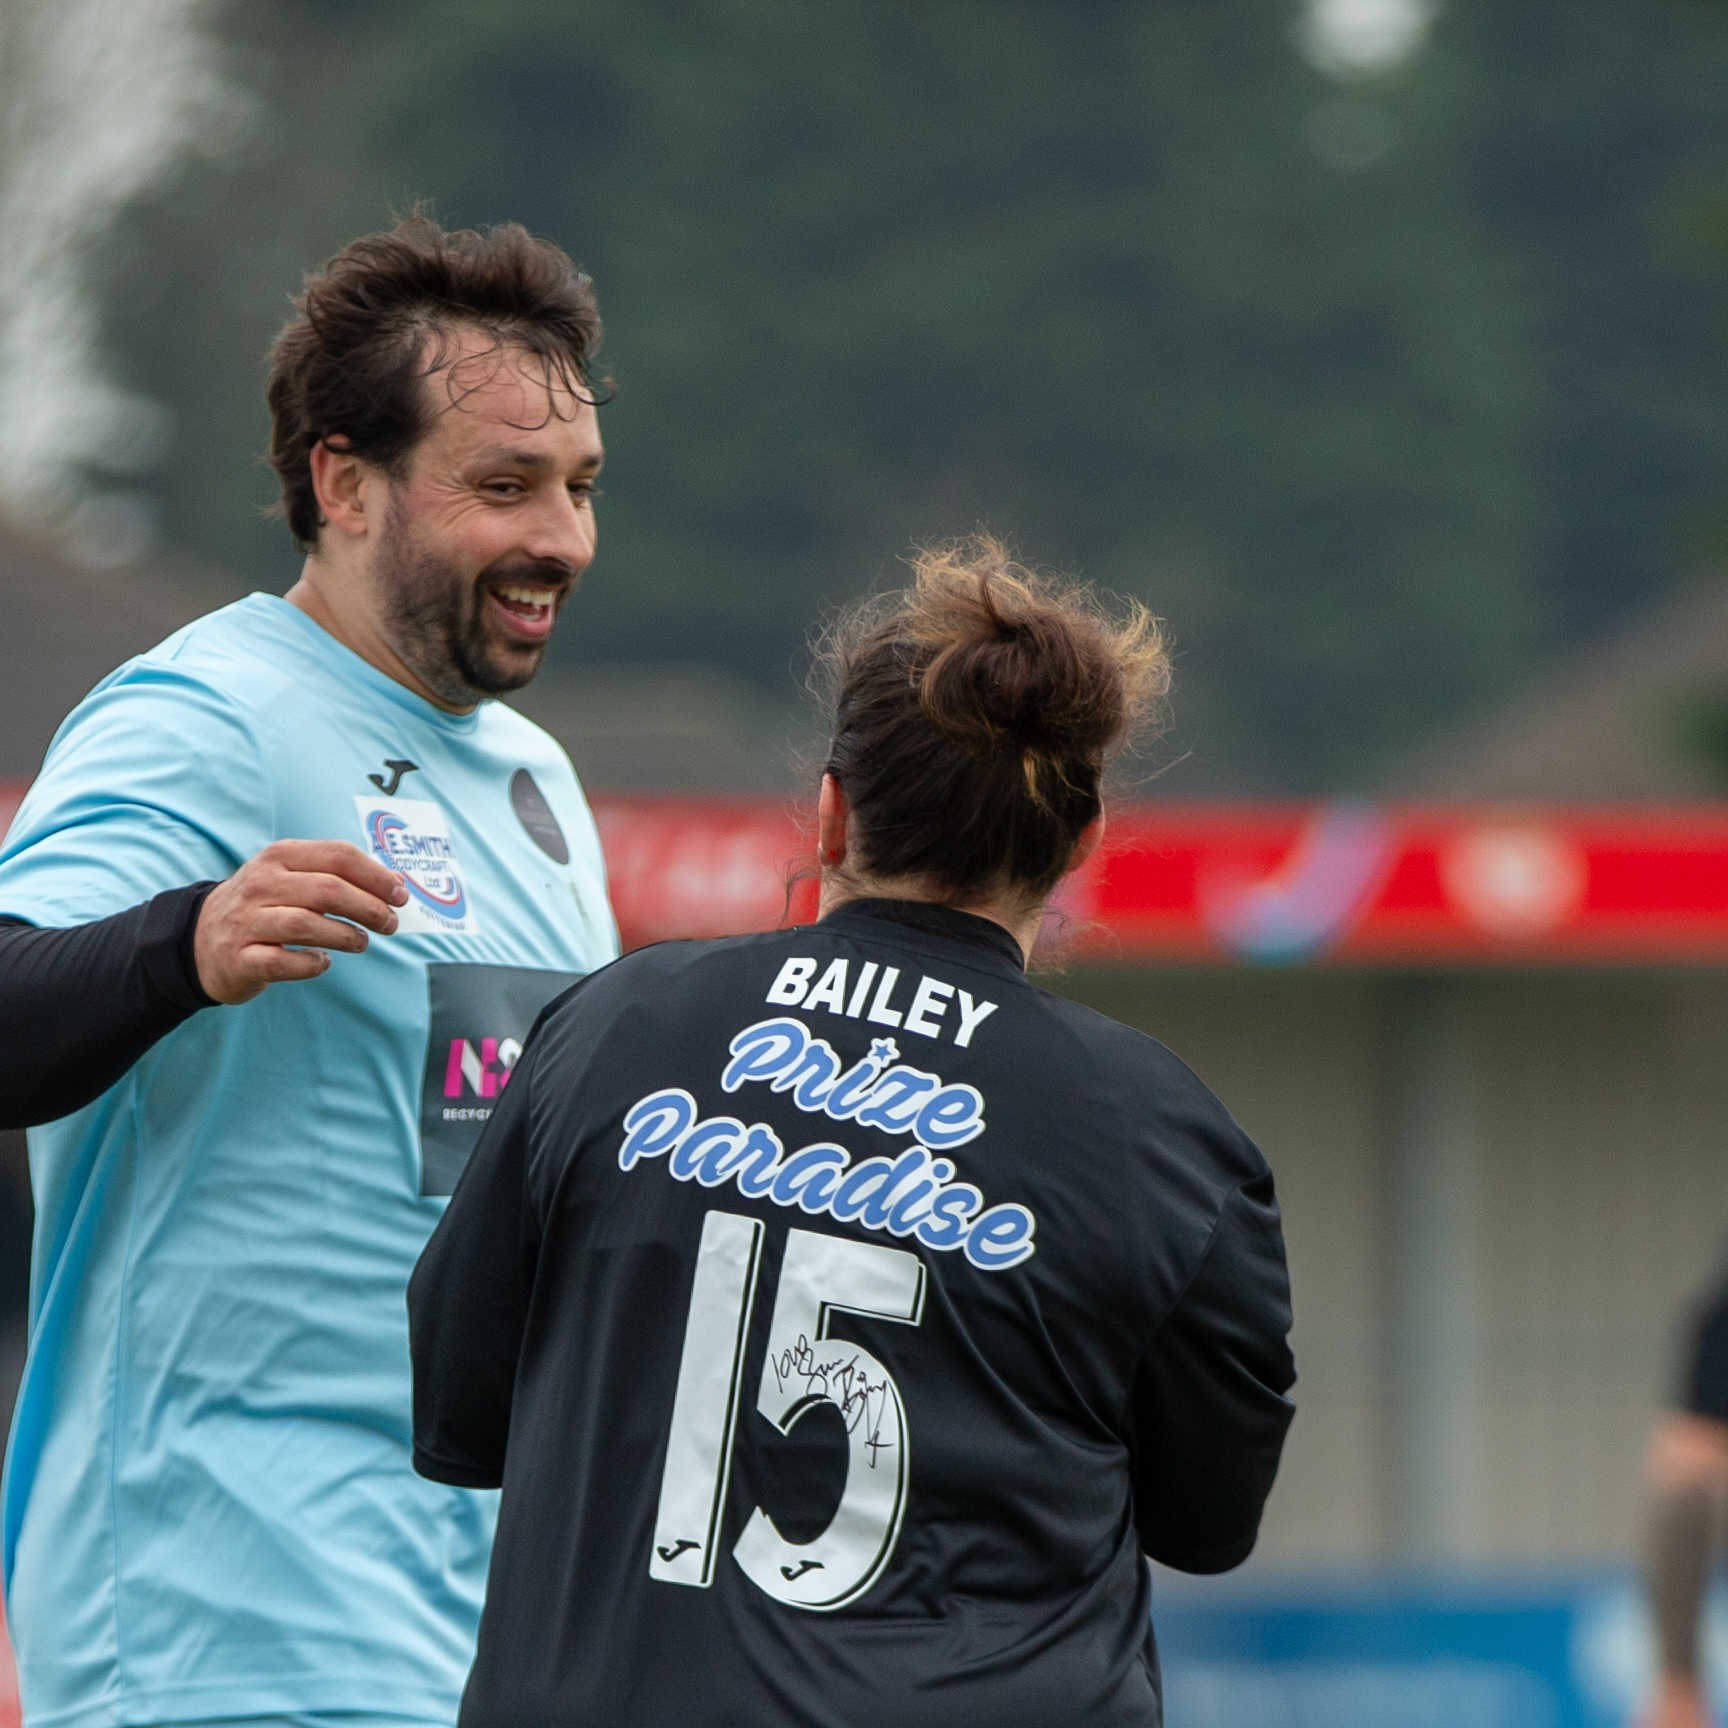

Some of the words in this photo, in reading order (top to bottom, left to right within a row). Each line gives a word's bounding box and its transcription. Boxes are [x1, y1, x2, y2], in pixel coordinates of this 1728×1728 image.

[766, 957, 998, 1048] BAILEY
[442, 1107, 494, 1121] RECYC
[721, 1017, 985, 1150] Prize
[618, 1087, 1036, 1271] Paradise
[649, 1210, 927, 1613] 15
